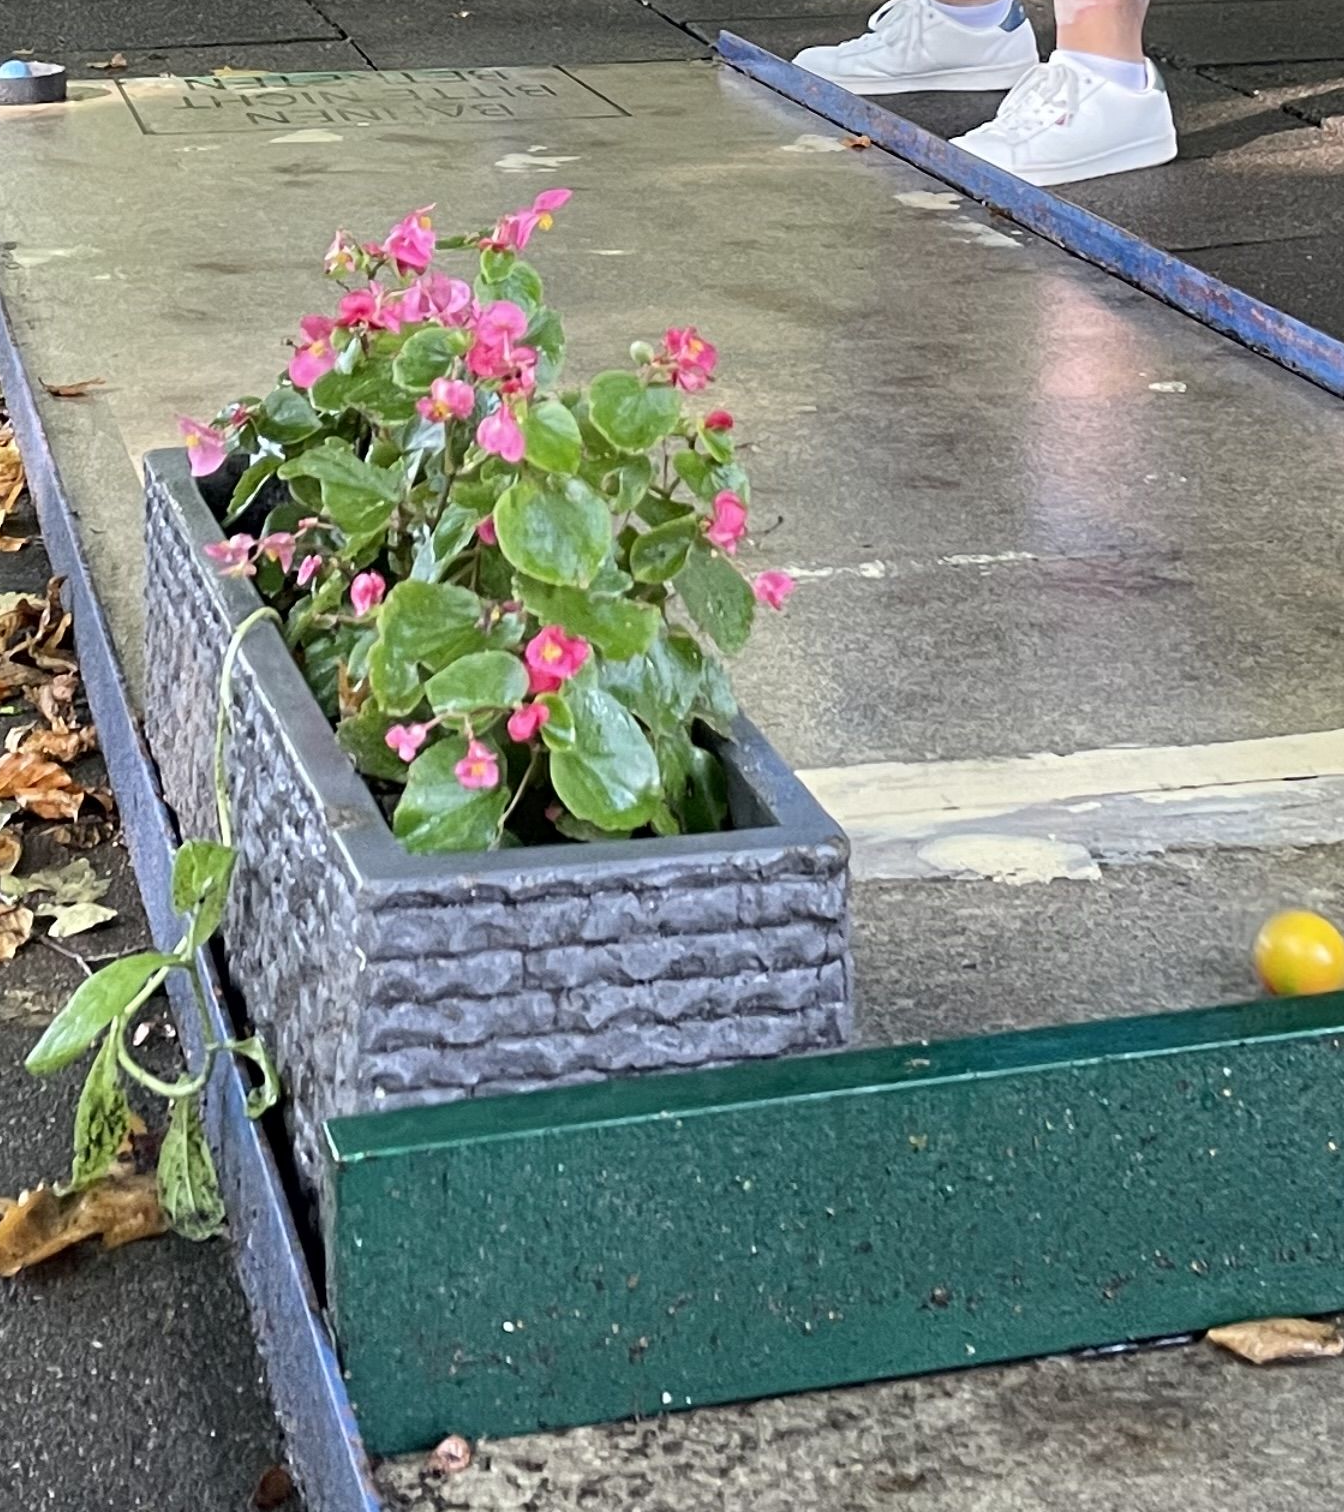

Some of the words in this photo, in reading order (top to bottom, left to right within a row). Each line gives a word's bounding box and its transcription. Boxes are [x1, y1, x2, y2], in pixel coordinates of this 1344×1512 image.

[174, 90, 364, 109] NICHT
[382, 84, 557, 101] BITTE
[246, 103, 514, 124] BAHNEN
